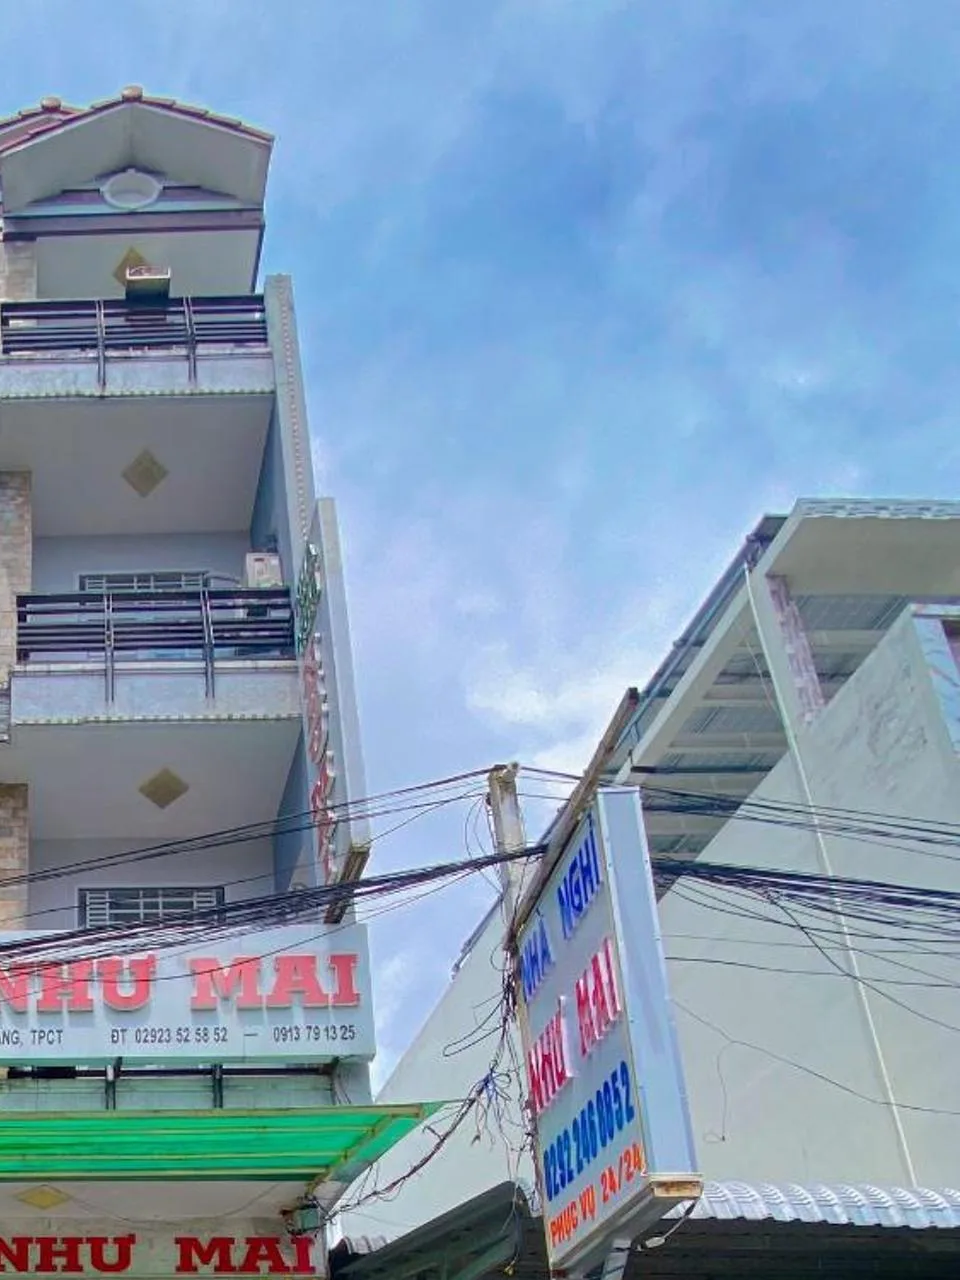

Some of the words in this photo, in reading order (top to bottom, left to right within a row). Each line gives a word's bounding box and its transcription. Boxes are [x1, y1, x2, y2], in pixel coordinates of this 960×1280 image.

[188, 953, 360, 1010] MAI
[576, 936, 621, 1058] MAI
[31, 1028, 64, 1046] TPCT
[110, 1027, 128, 1045] ĐT
[175, 1027, 191, 1044] 52
[213, 1026, 229, 1044] 52
[273, 1026, 301, 1043] 0913
[306, 1026, 321, 1043] 79
[325, 1025, 338, 1042] 13
[340, 1024, 356, 1042] 25
[175, 1236, 317, 1274] MAI
